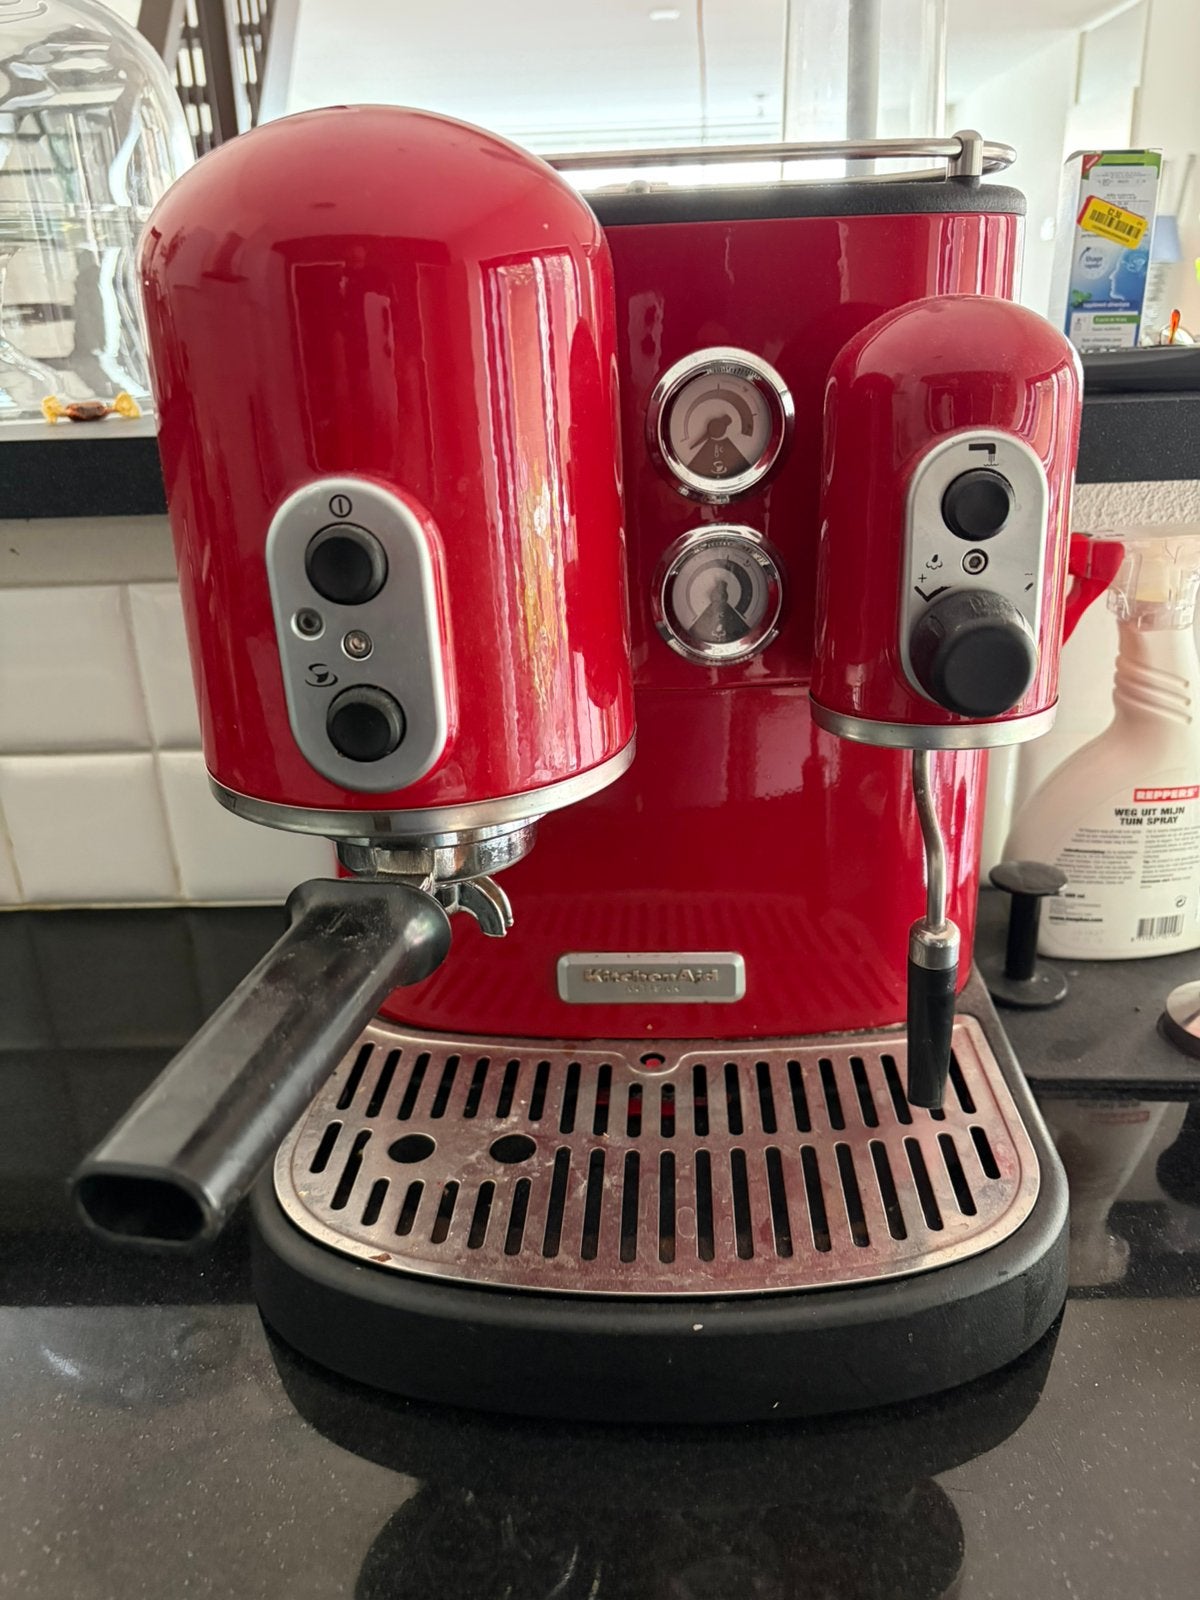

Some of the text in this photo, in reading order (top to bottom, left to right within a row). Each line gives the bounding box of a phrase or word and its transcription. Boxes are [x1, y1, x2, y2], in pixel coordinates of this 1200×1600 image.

[1114, 806, 1186, 817] WEG UIT MIJN
[1119, 816, 1179, 826] TUIN SPRAY
[583, 967, 720, 984] KitchenAid
